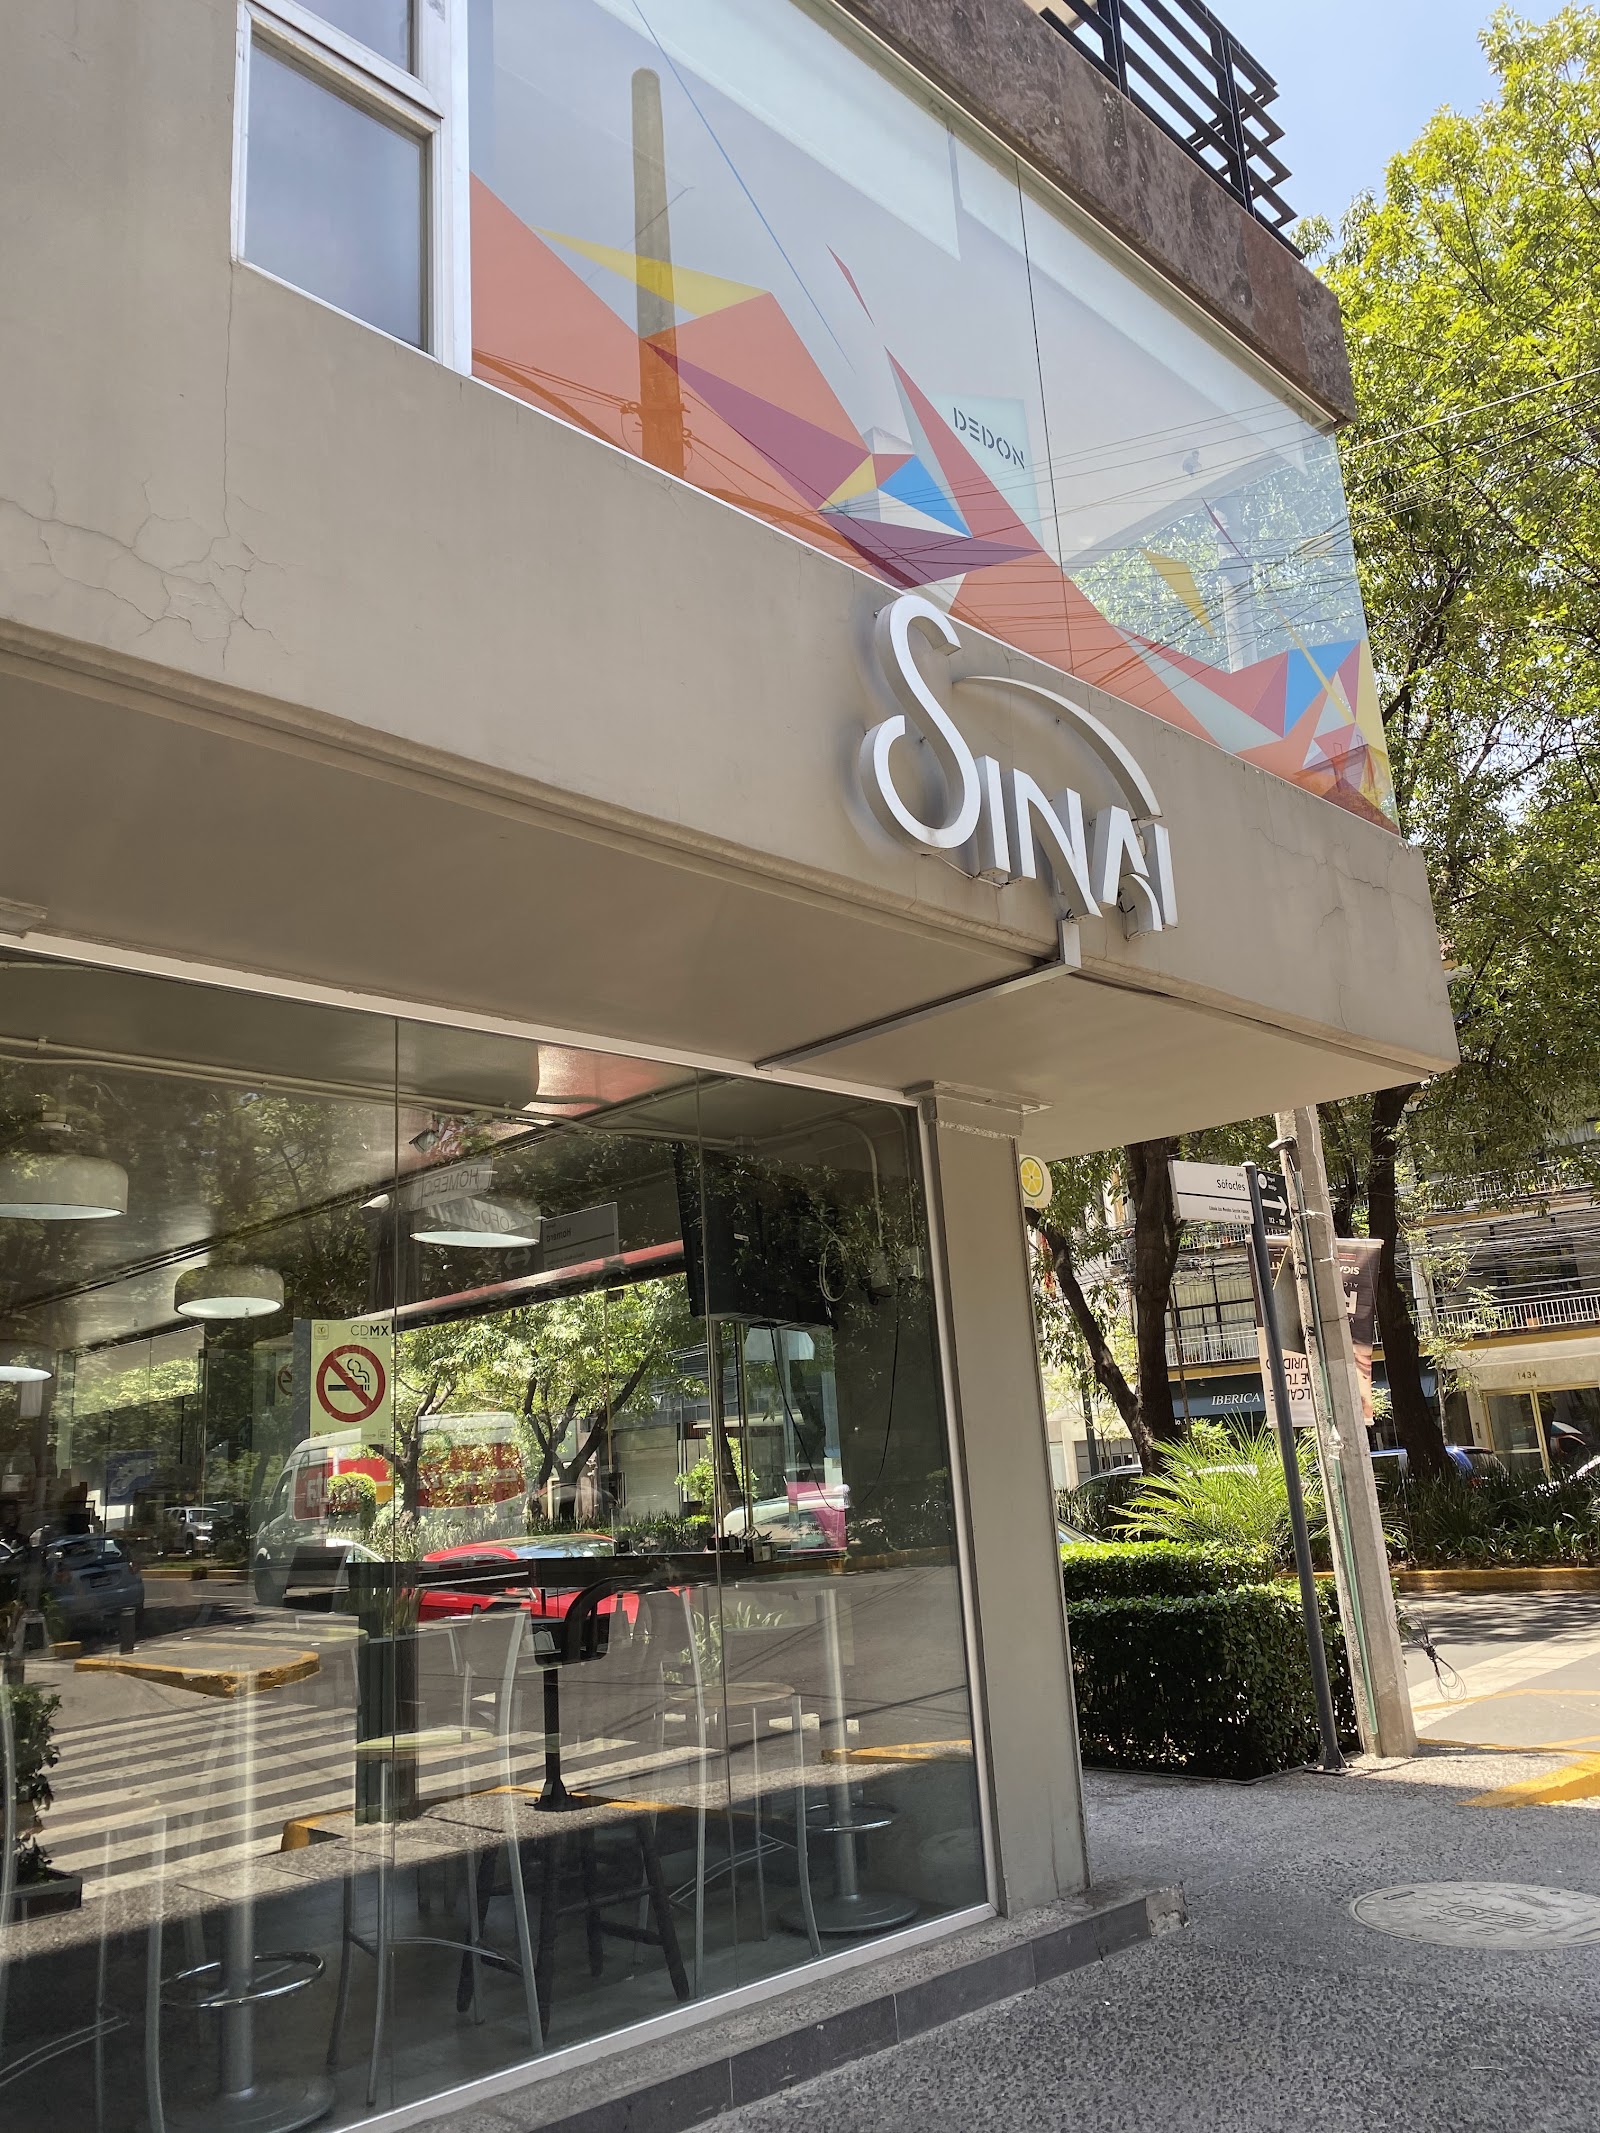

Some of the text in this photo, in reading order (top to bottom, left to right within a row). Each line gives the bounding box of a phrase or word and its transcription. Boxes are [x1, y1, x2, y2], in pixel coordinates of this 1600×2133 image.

[953, 407, 1024, 470] DEDON
[350, 1324, 389, 1337] CDMX
[1517, 1370, 1537, 1380] 1434
[1211, 1393, 1260, 1405] IBERICA
